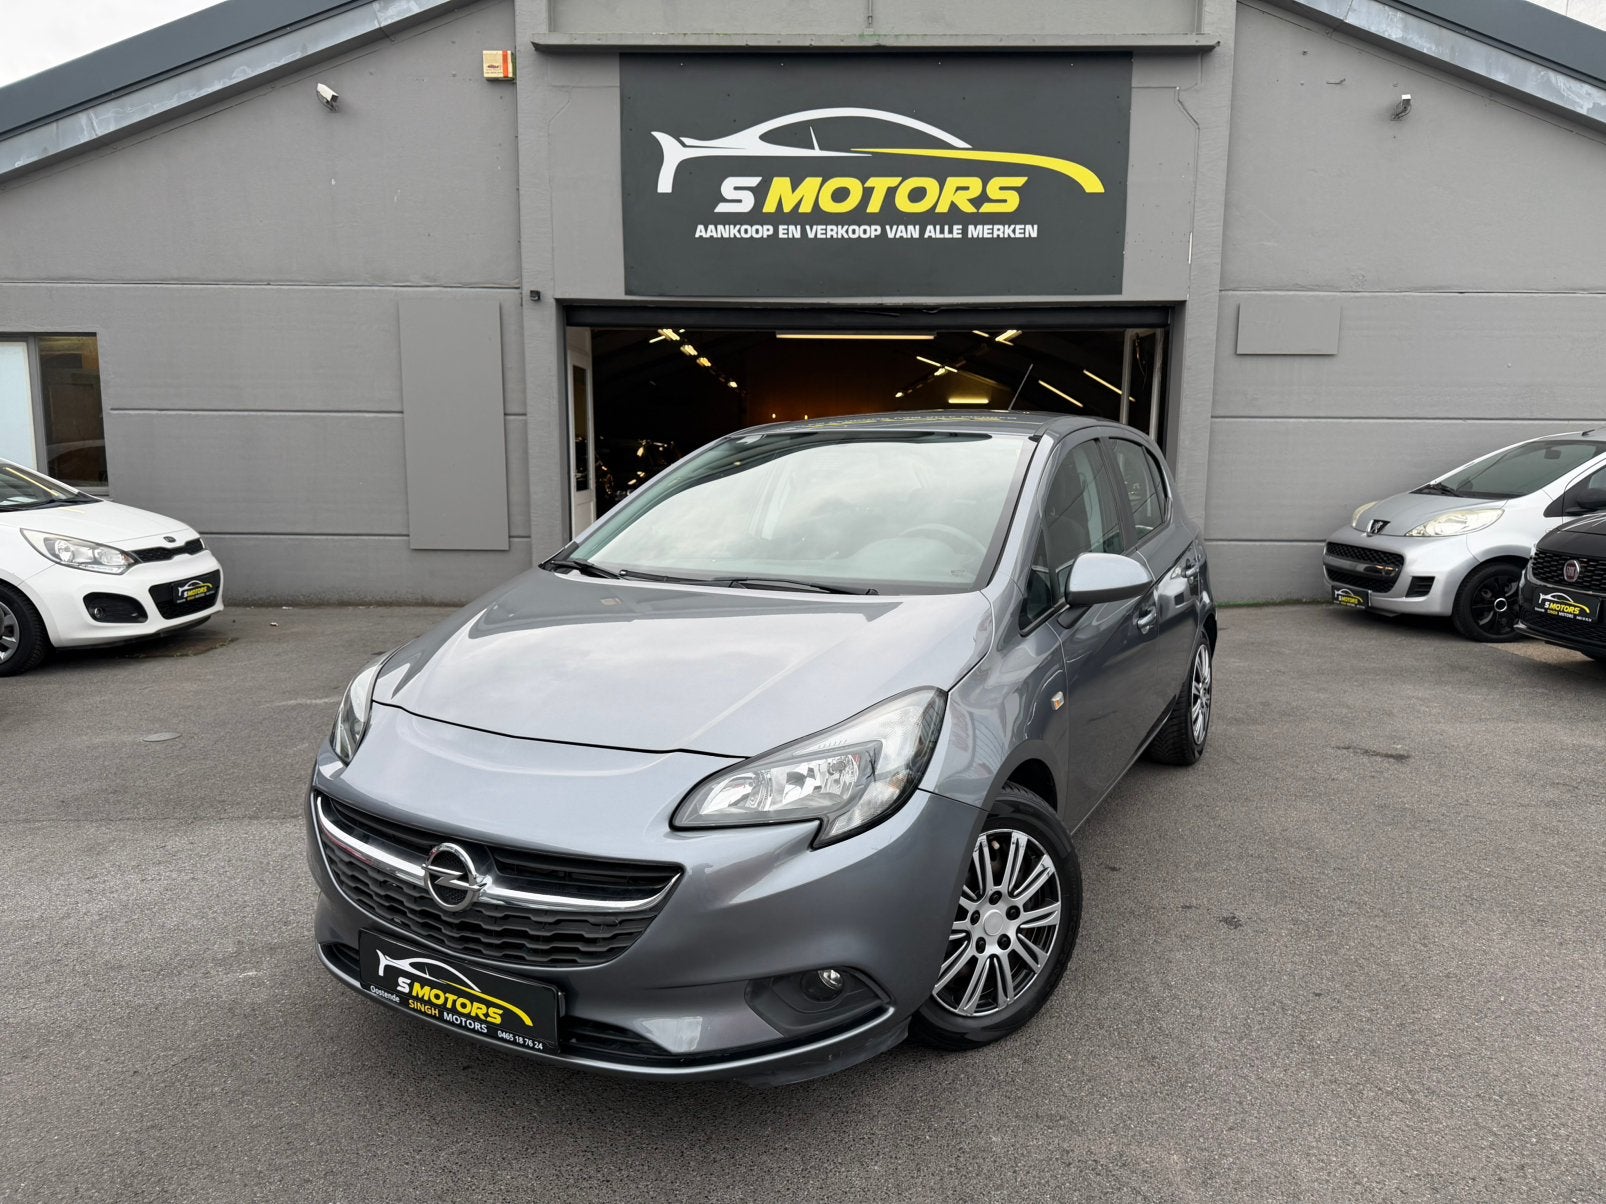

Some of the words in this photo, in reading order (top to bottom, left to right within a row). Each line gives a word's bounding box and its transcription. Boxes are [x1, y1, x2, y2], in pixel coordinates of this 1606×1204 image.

[714, 176, 762, 213] S
[762, 176, 1028, 213] MOTORS
[694, 224, 774, 239] AANKOOP
[778, 224, 801, 239] EN
[805, 224, 882, 239] VERKOOP
[886, 224, 920, 239] VAN
[924, 224, 962, 239] ALLE
[967, 224, 1038, 239] MERKEN
[1550, 602, 1580, 614] MOTORS
[370, 985, 400, 1003] Oostende
[408, 999, 439, 1017] SINGH
[443, 1011, 488, 1033] MOTORS
[497, 1030, 514, 1041] 0465
[396, 976, 412, 993] S
[412, 981, 504, 1024] MOTORS
